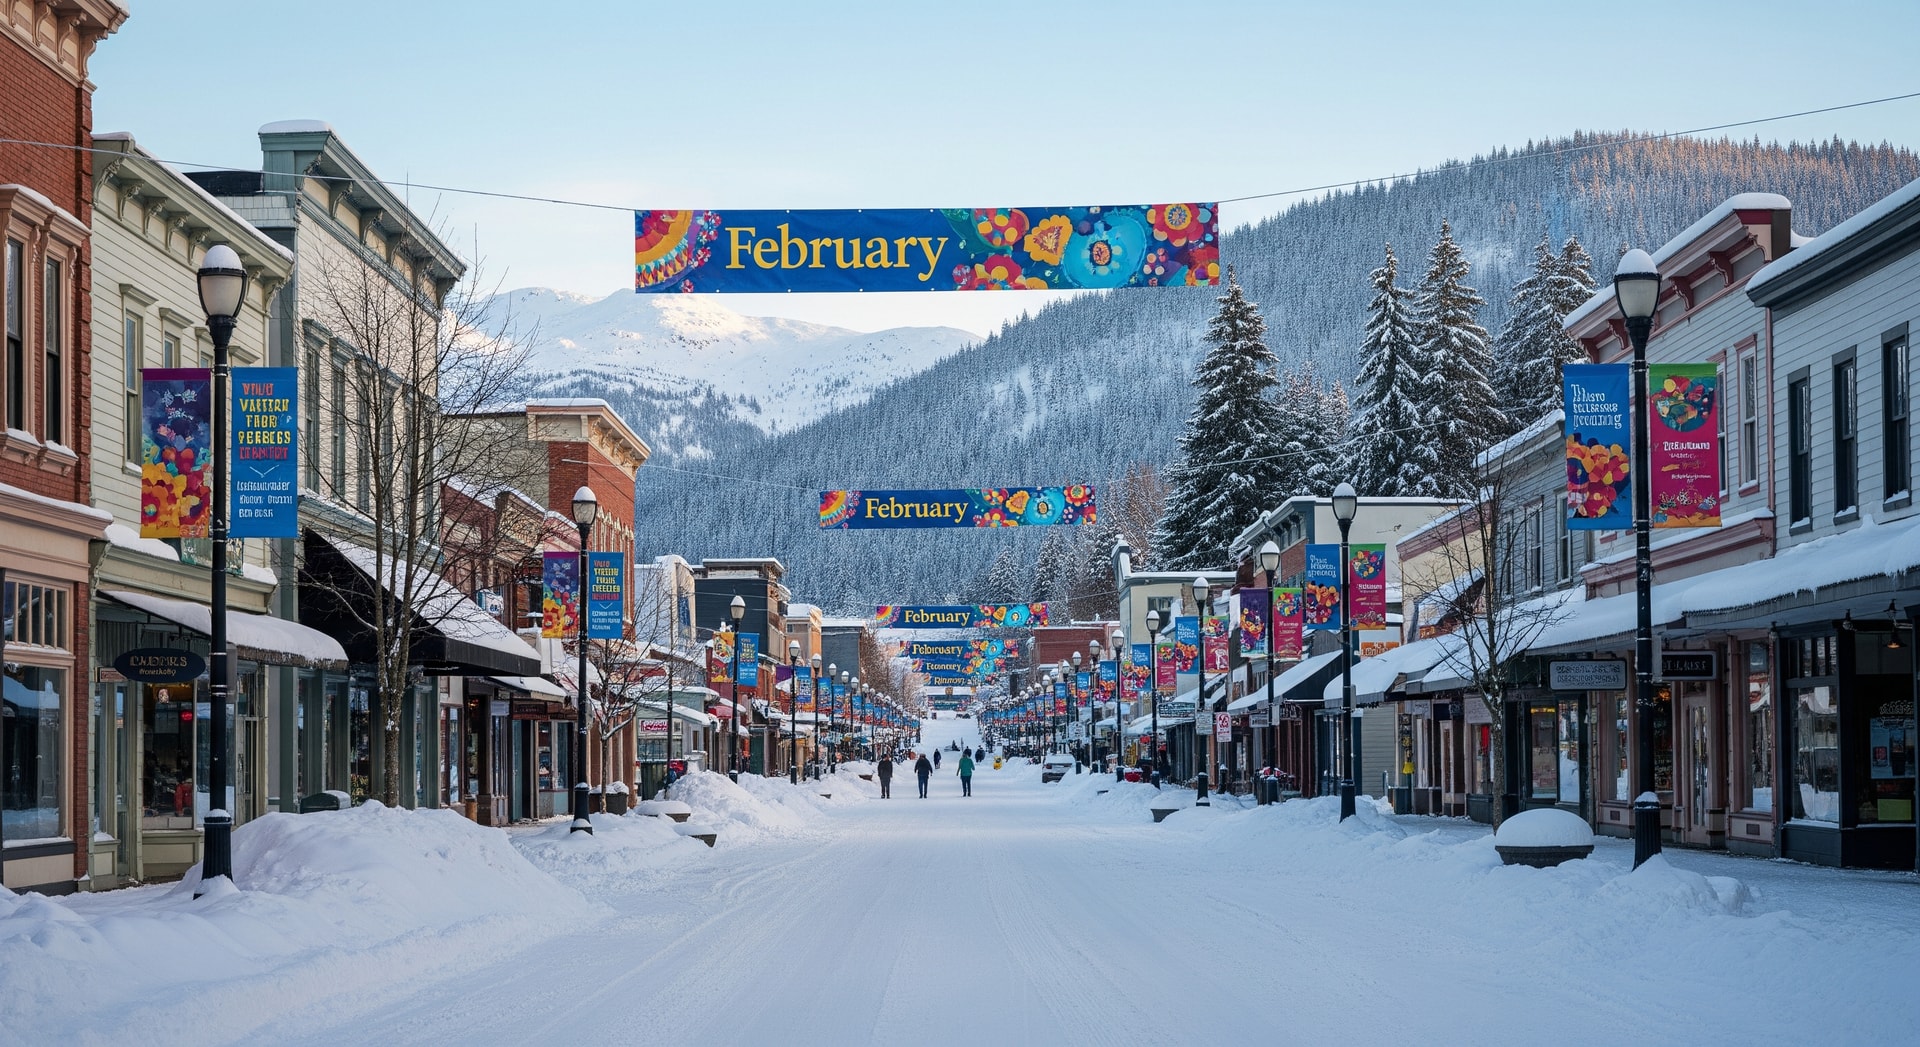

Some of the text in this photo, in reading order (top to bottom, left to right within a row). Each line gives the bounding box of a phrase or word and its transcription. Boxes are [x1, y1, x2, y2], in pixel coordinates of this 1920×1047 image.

[725, 223, 947, 281] February
[865, 497, 968, 523] February
[904, 609, 971, 626] February
